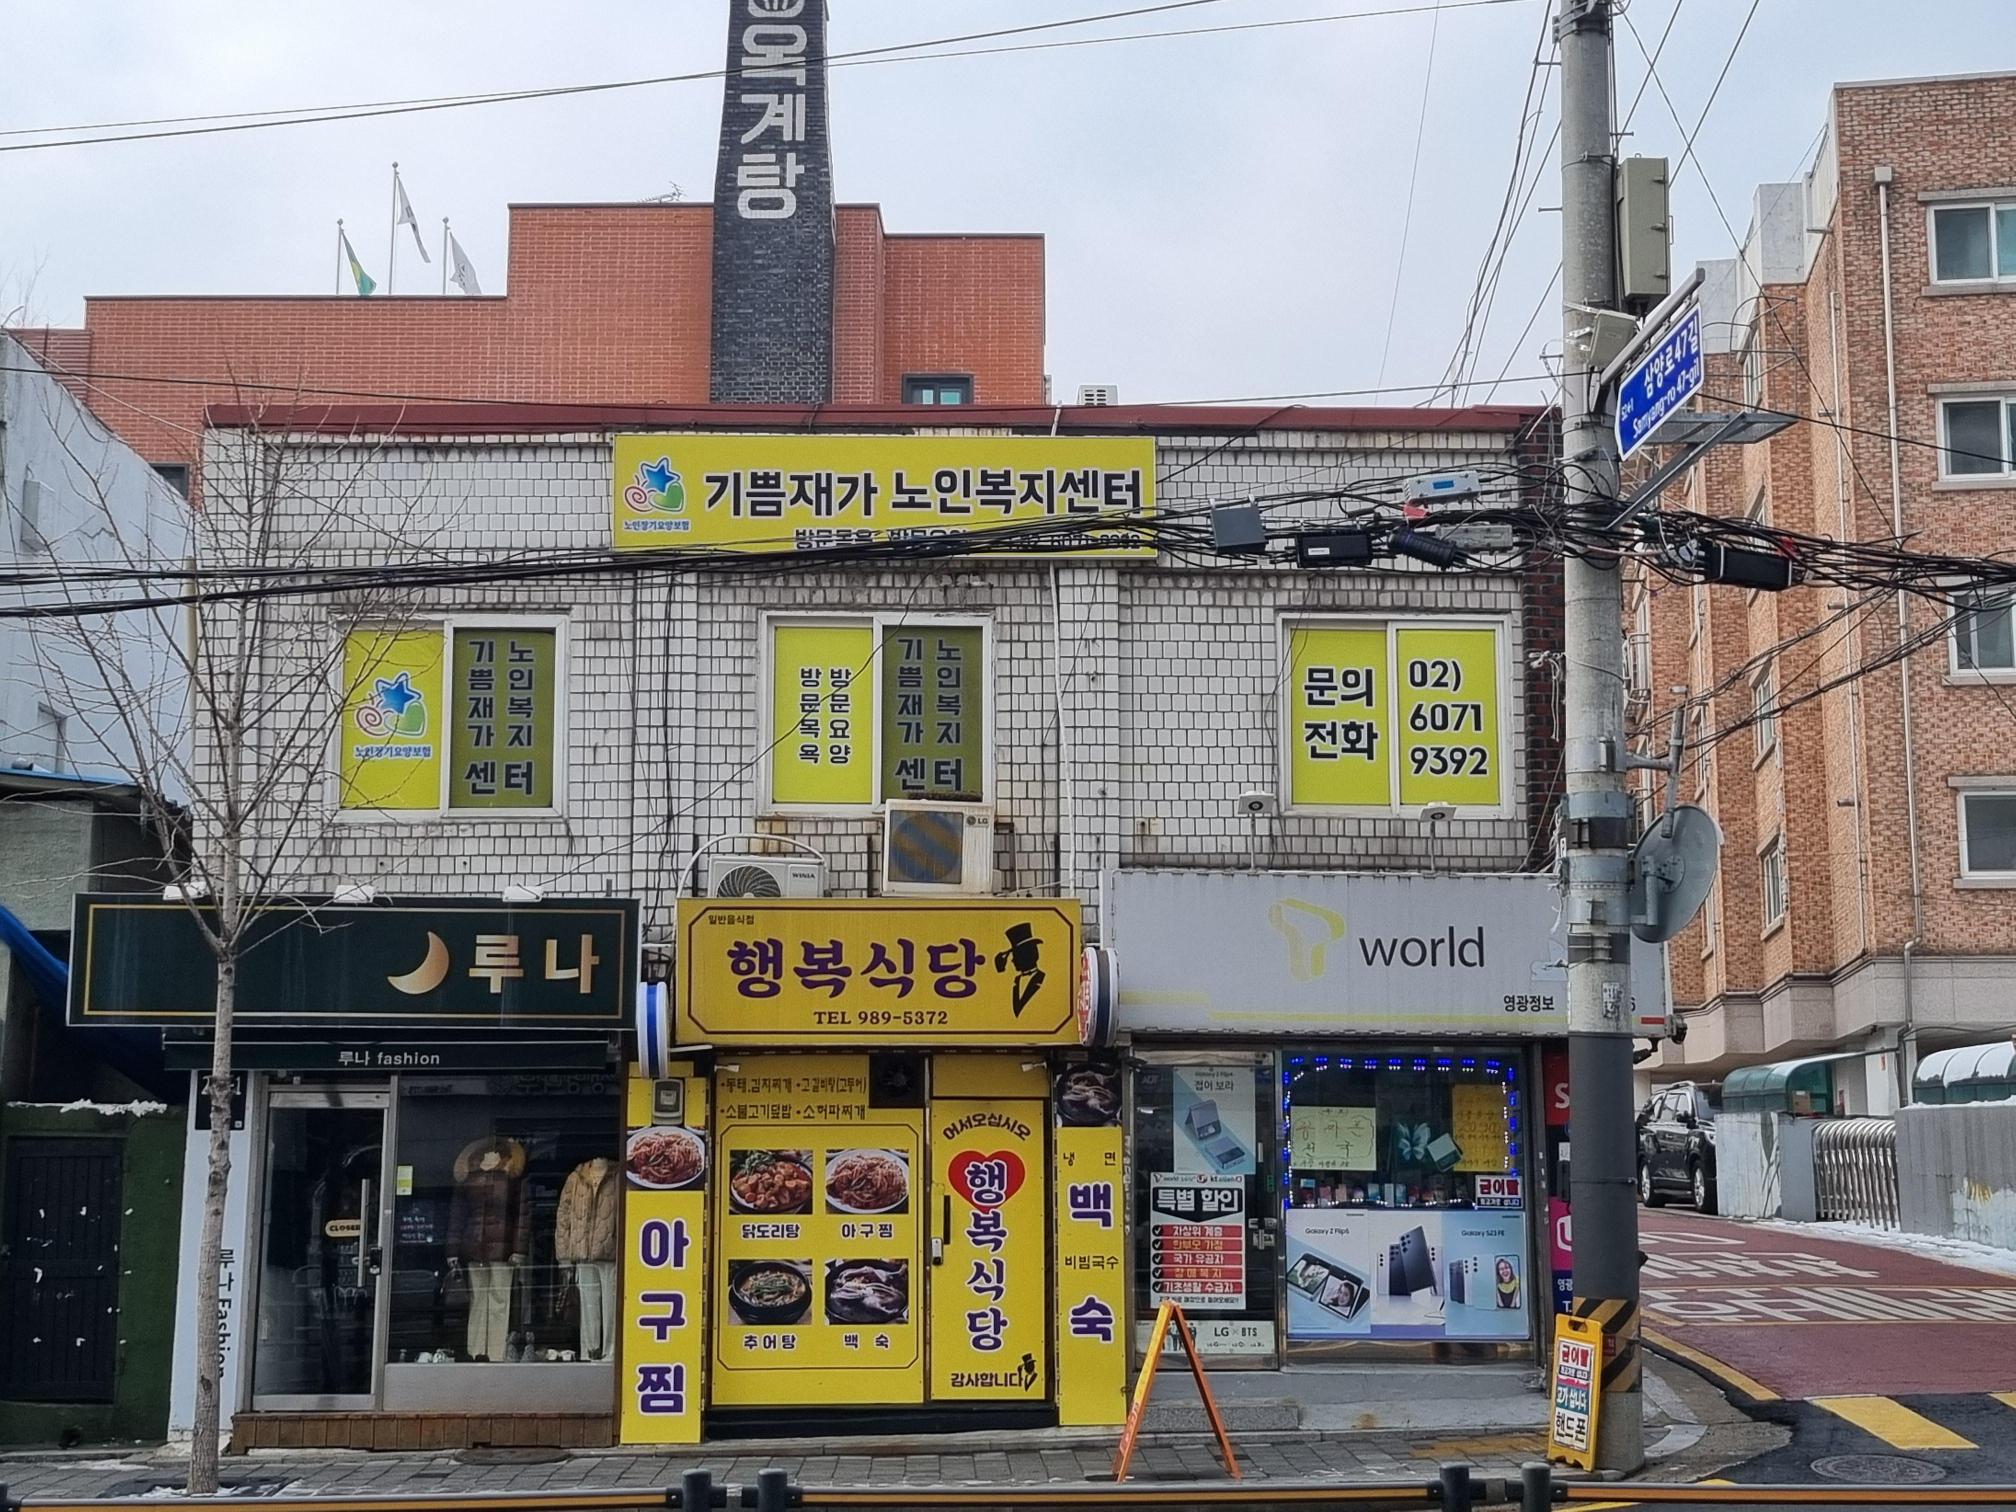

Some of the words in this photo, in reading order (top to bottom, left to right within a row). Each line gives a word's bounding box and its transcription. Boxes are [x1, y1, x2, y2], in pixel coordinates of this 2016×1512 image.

[1644, 316, 1699, 399] 삼양로47길
[1633, 386, 1677, 439] Samyang-ro
[1676, 356, 1700, 397] 47-gil
[704, 470, 877, 516] 기쁨재가
[891, 469, 1142, 516] 노인복지센터
[897, 639, 923, 743] 기쁨재가
[936, 639, 962, 743] 노인복지
[1304, 668, 1373, 707] 문의
[1409, 660, 1462, 692] 02)
[467, 641, 494, 747] 기쁨재가
[508, 641, 535, 747] 노인복지
[799, 668, 821, 763] 방문목욕
[829, 668, 851, 764] 방문요양
[1410, 704, 1482, 731] 6071
[1305, 721, 1378, 760] 전화
[895, 758, 963, 791] 센터
[1411, 747, 1488, 775] 9392
[465, 761, 534, 795] 센터
[708, 914, 755, 926] 일반음식점
[1359, 925, 1485, 968] world
[468, 933, 599, 994] 루나
[727, 937, 986, 999] 행복식당
[813, 1011, 852, 1025] TEL
[858, 1010, 948, 1026] 989-5372
[1503, 994, 1555, 1012] 영광정보
[338, 1051, 370, 1066] 루나
[377, 1051, 440, 1066] fashion
[943, 1113, 1031, 1141] 어서오십시오
[1157, 1190, 1195, 1211] 특별
[1201, 1189, 1238, 1212] 할인
[742, 1224, 800, 1239] 닭도리탕
[841, 1224, 893, 1239] 아구찜
[1305, 1228, 1329, 1236] Galaxy
[1461, 1230, 1486, 1238] Galaxy
[966, 1160, 1009, 1350] 행복식당
[1065, 1256, 1119, 1270] 비빔국수
[638, 1220, 689, 1413] 아구찜
[1214, 1327, 1229, 1337] LG
[1241, 1327, 1257, 1337] BTS
[744, 1335, 797, 1349] 추어탕
[951, 1373, 1023, 1387] 감사합니다
[1556, 1413, 1586, 1443] 핸드폰
